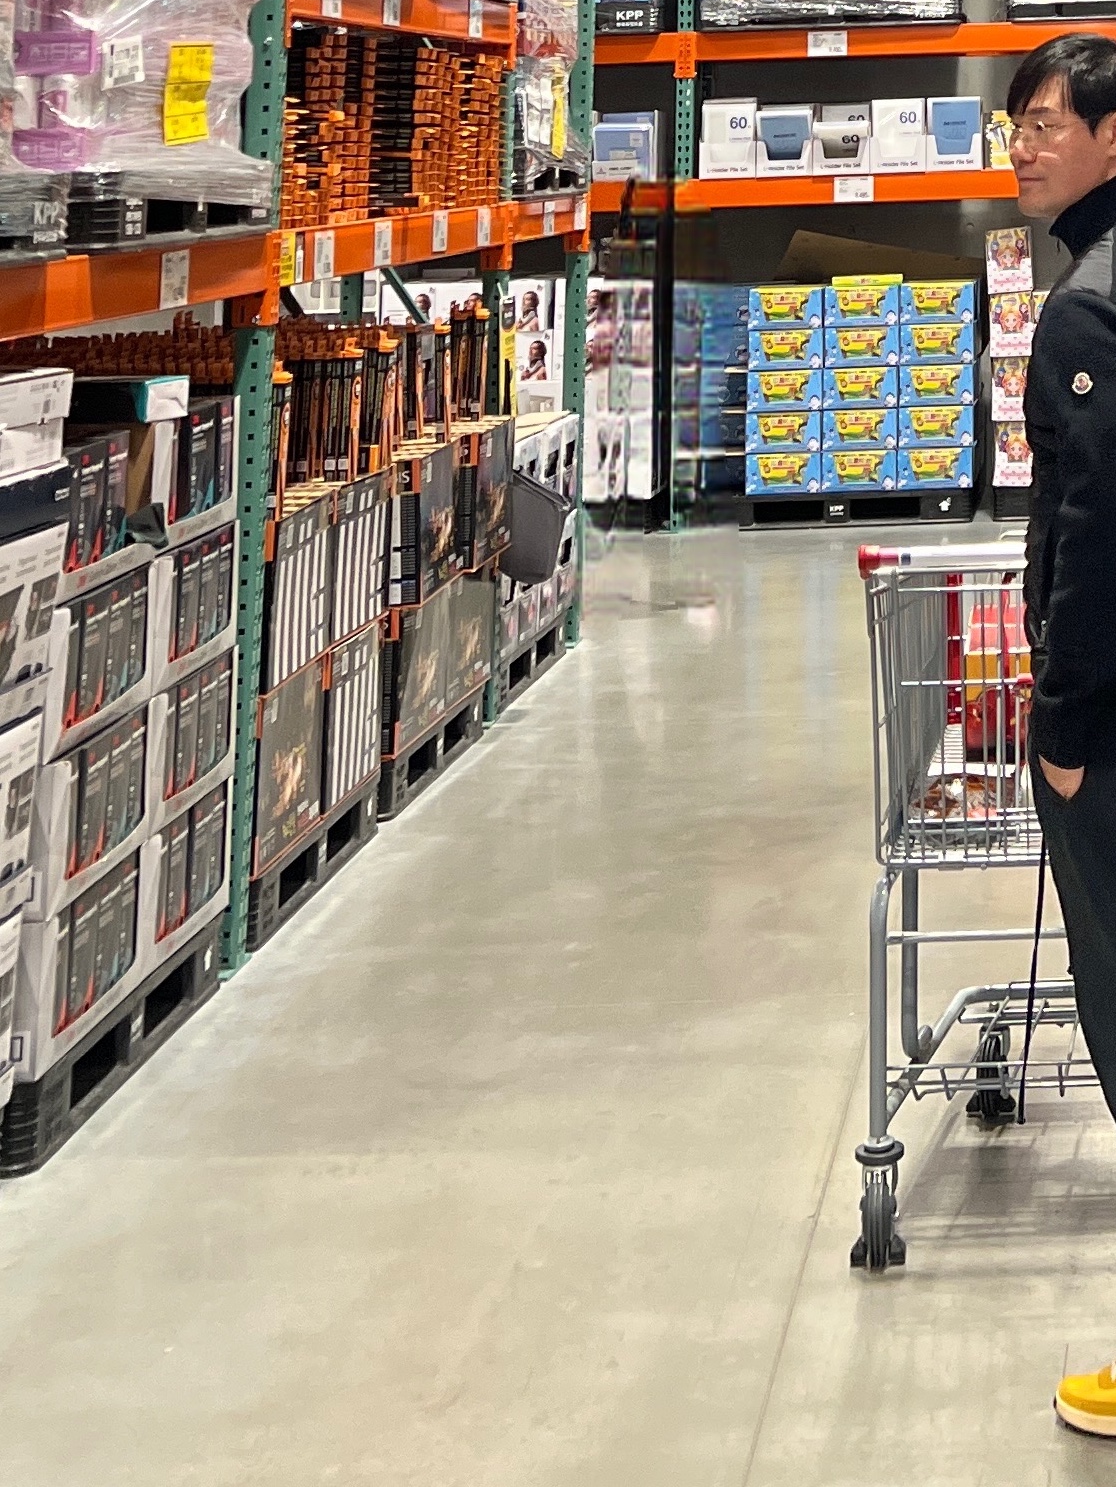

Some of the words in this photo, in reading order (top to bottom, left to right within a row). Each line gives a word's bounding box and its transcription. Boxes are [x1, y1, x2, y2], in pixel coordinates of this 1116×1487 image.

[615, 10, 644, 21] KPP
[729, 116, 747, 129] 60
[900, 111, 917, 124] 60
[841, 134, 860, 144] 60
[33, 201, 60, 225] KPP
